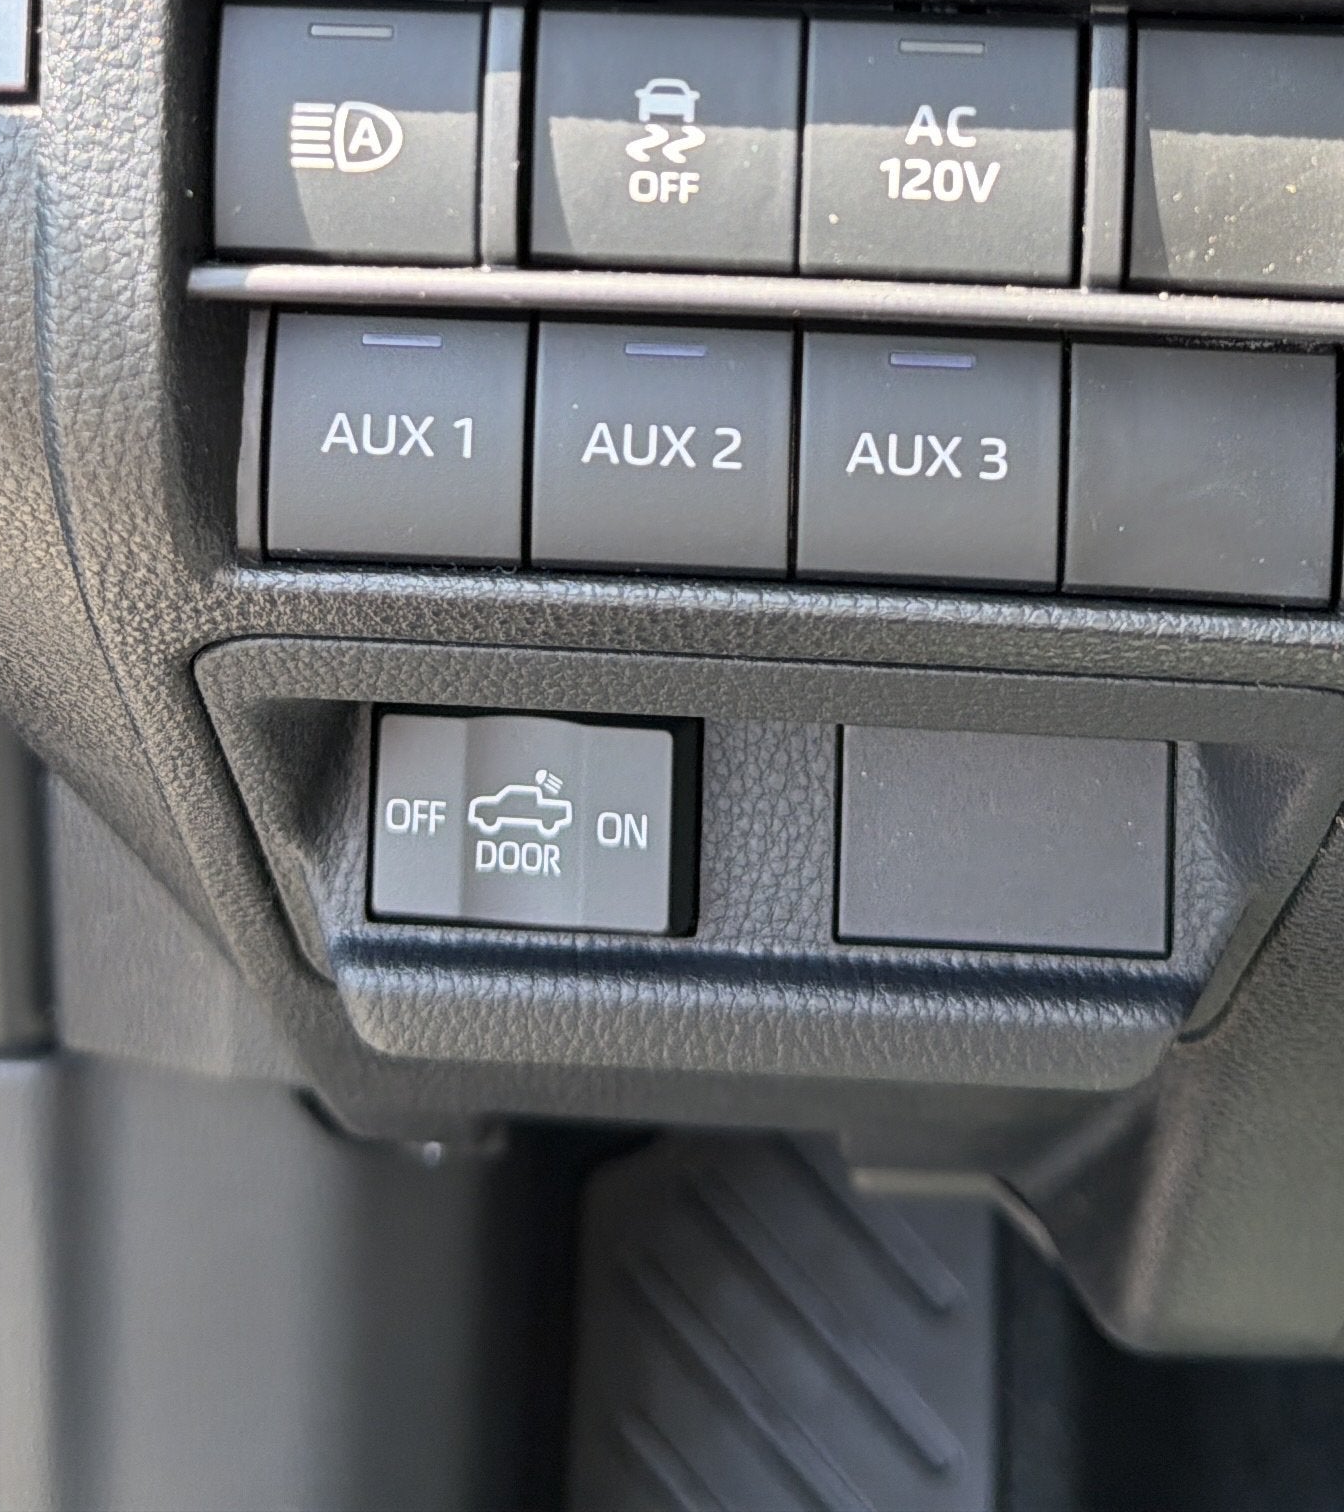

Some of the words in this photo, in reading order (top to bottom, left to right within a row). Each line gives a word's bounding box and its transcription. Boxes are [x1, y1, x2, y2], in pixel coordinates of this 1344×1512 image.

[348, 117, 382, 155] A
[904, 104, 977, 149] AC
[628, 170, 700, 204] OFF
[879, 157, 1001, 203] 120V
[320, 412, 435, 457] AUX
[453, 417, 474, 459] 1
[580, 422, 696, 468] AUX
[712, 427, 743, 470] 2
[845, 432, 962, 478] AUX
[979, 437, 1008, 481] 3
[385, 798, 447, 835] OFF
[596, 811, 648, 849] ON
[475, 840, 561, 877] DOOR
